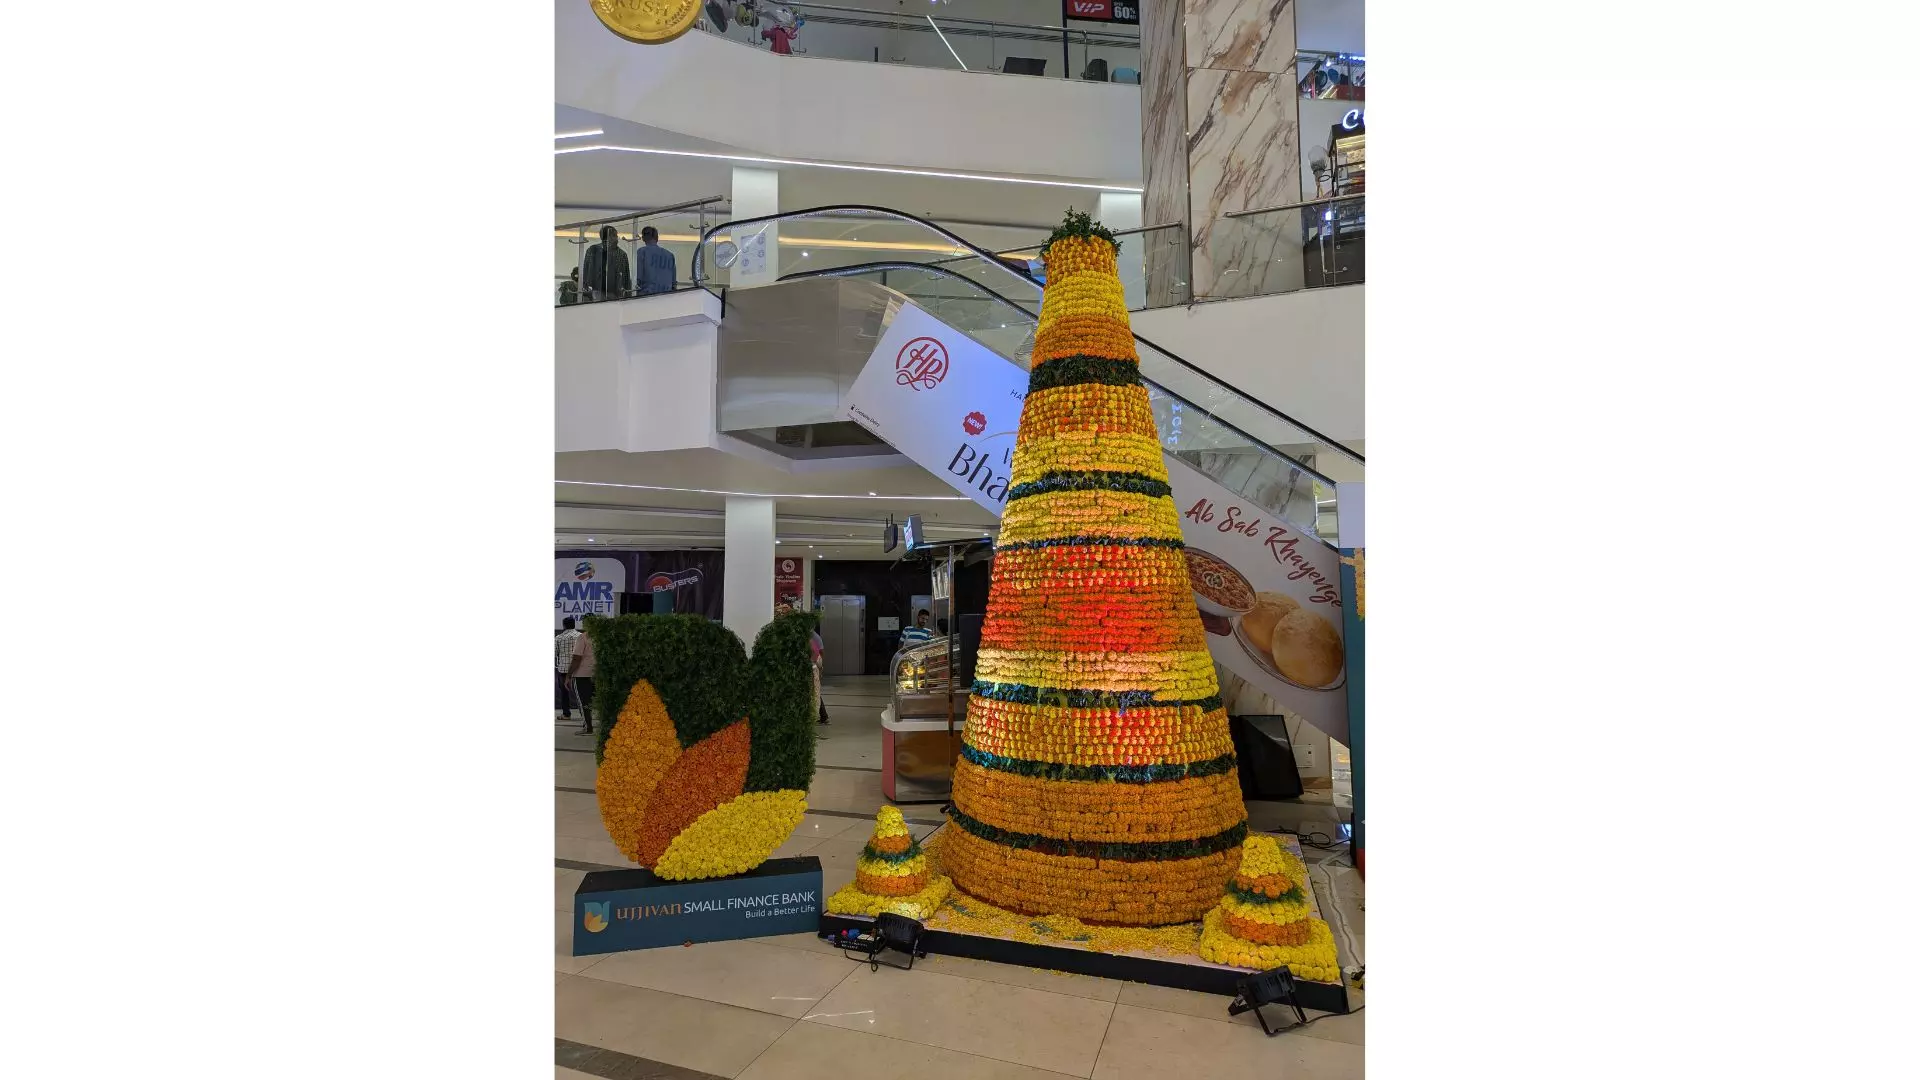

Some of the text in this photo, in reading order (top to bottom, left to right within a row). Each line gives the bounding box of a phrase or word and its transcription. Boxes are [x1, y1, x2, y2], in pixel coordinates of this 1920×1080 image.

[1074, 2, 1105, 13] VIP
[1185, 498, 1214, 524] Ab
[1217, 506, 1261, 537] Sab
[555, 581, 613, 600] AMR
[653, 575, 699, 592] BUSTERS
[555, 601, 613, 613] PLANET
[684, 901, 725, 914] SMALL
[727, 894, 780, 909] FINANCE
[782, 890, 815, 904] BANK
[745, 909, 766, 919] Build
[774, 906, 799, 916] Better
[800, 904, 815, 913] Life
